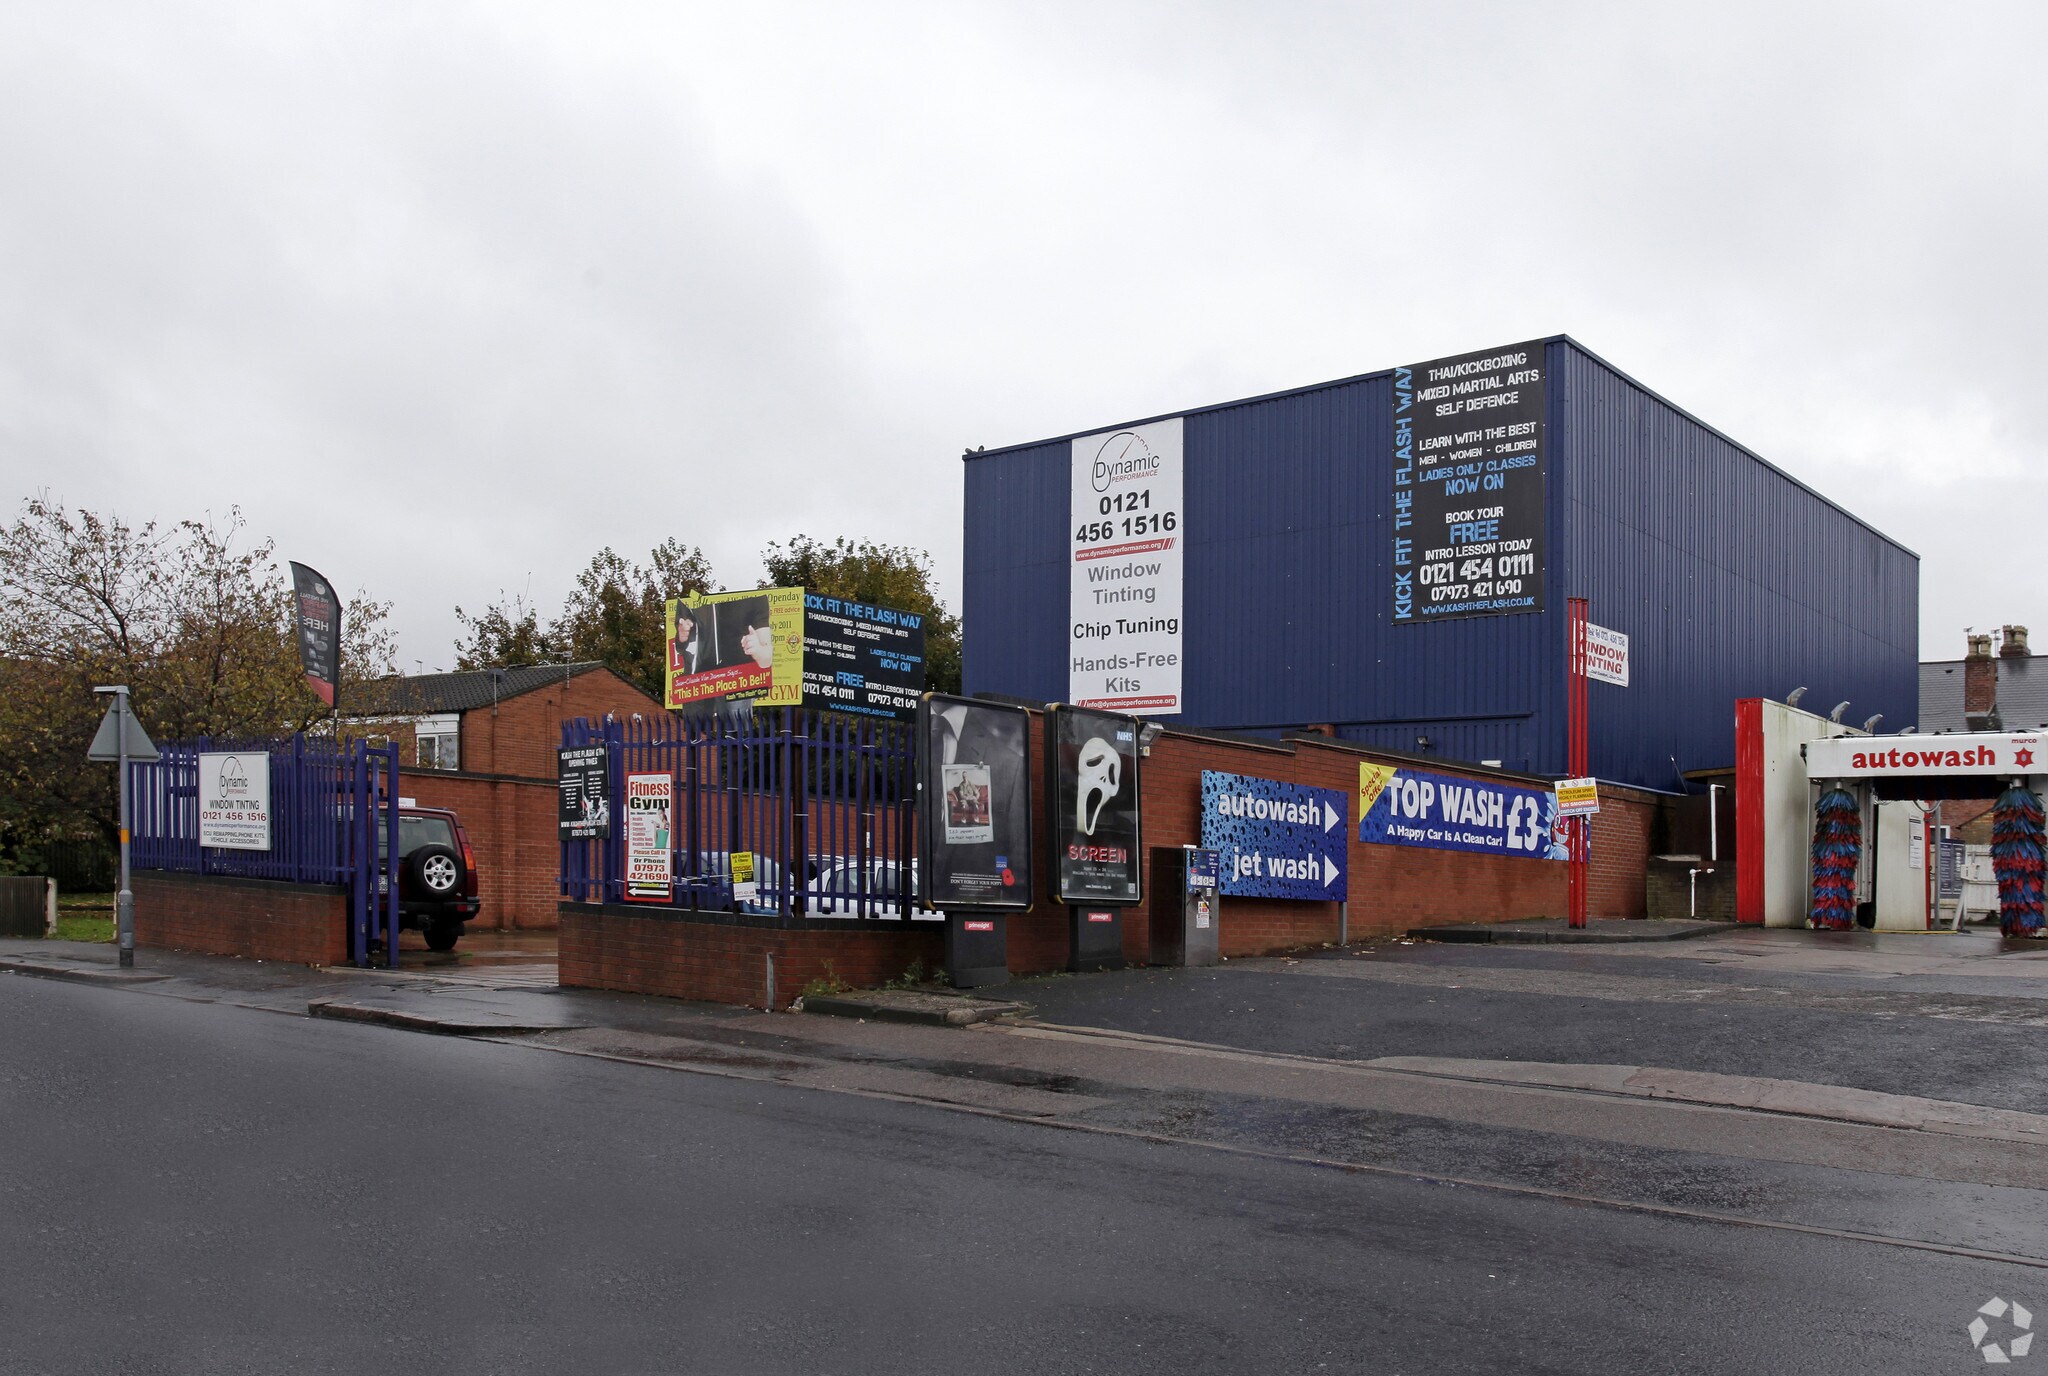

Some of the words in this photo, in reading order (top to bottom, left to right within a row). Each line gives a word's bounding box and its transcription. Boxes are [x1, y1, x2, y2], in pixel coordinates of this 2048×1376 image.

[1428, 352, 1527, 381] THAI/KICKBOXING
[1395, 367, 1412, 414] WAY
[1417, 386, 1450, 402] MIXED
[1452, 376, 1504, 396] MARTIAL
[1507, 369, 1540, 386] ARTS
[1436, 401, 1464, 417] SELF
[1466, 391, 1519, 412] DEFENCE
[1419, 434, 1452, 451] LEARN
[1455, 430, 1482, 444] WITH
[1485, 426, 1506, 440] THE
[1508, 422, 1537, 437] BEST
[1395, 417, 1412, 486] FLASH
[1419, 455, 1437, 466] MEN
[1449, 448, 1482, 461] WOMEN
[1495, 439, 1537, 454] CHILDREN
[1095, 453, 1160, 482] Dynamic
[1111, 469, 1158, 483] PERFORMANCE
[1419, 466, 1454, 482] LADIES
[1456, 461, 1484, 476] ONLY
[1486, 454, 1536, 471] CLASSES
[1446, 477, 1479, 497] NOW
[1484, 473, 1504, 490] ON
[1099, 489, 1150, 516] 0121
[1395, 490, 1412, 531] THE
[1446, 509, 1474, 524] BOOK
[1477, 506, 1504, 519] YOUR
[1076, 520, 1114, 543] 456
[1121, 511, 1177, 537] 1516
[1450, 519, 1499, 545] FREE
[1076, 542, 1161, 560] www.dynamicperformance.org
[1395, 537, 1412, 566] FIT
[1425, 547, 1454, 561] INTRO
[1456, 542, 1496, 557] LESSON
[1498, 538, 1533, 552] TODAY
[1087, 562, 1162, 583] Window
[1420, 561, 1455, 585] 0121
[1460, 557, 1493, 581] 454
[1498, 553, 1534, 577] 0111
[768, 591, 801, 604] Openday
[1092, 586, 1156, 605] Tinting
[1395, 570, 1412, 619] KICK
[1431, 583, 1469, 601] 07973
[1473, 581, 1493, 597] 421
[1496, 579, 1522, 595] 690
[826, 598, 841, 613] FIT
[844, 602, 863, 619] THE
[865, 606, 897, 625] FLASH
[899, 613, 921, 629] WAY
[1421, 596, 1535, 615] WWW.KASHTHEFLASH.CO.UK
[778, 620, 792, 629] 2011
[843, 627, 857, 636] SELF
[856, 630, 881, 641] DEFENCE
[855, 621, 872, 631] MIXED
[871, 624, 895, 636] MARTIAL
[895, 629, 909, 638] ARTS
[1073, 622, 1112, 640] Chip
[1115, 617, 1179, 635] Tuning
[818, 638, 832, 648] WITH
[832, 642, 843, 650] THE
[842, 644, 856, 652] BEST
[869, 648, 887, 656] LADIES
[887, 651, 900, 660] ONLY
[899, 654, 922, 663] CLASSES
[880, 658, 899, 670] NOW
[900, 662, 911, 672] ON
[1073, 652, 1178, 673] Hands-Free
[692, 685, 699, 697] Is
[701, 683, 714, 695] The
[716, 680, 737, 693] Place
[739, 677, 748, 688] To
[769, 683, 800, 701] GYM
[803, 682, 820, 695] 0121
[821, 685, 837, 698] 454
[838, 688, 855, 700] 0111
[818, 674, 834, 684] YOUR
[836, 671, 864, 688] FREE
[865, 681, 882, 691] INTRO
[882, 684, 904, 694] LESSON
[1105, 677, 1141, 693] Kits
[867, 692, 891, 706] 07973
[892, 696, 904, 707] 421
[1086, 698, 1175, 708] info@dynamicperformance.org
[1116, 731, 1133, 742] NHS
[1852, 745, 1996, 769] autowash
[220, 775, 249, 794] Dynamic
[630, 781, 670, 796] Fitness
[1360, 767, 1382, 797] Special
[1368, 779, 1384, 802] Offer
[209, 800, 235, 810] WINDOW
[236, 800, 260, 810] TINTING
[630, 796, 670, 810] Gym
[1218, 791, 1320, 826] autowash
[1385, 776, 1435, 820] TOP
[1439, 783, 1504, 829] WASH
[1506, 794, 1540, 851] £3
[202, 811, 222, 820] 0121
[225, 811, 243, 821] 456
[246, 812, 267, 822] 1516
[1386, 824, 1396, 835] A
[1397, 825, 1426, 842] Happy
[1426, 828, 1443, 840] Car
[1444, 830, 1452, 842] Is
[1453, 831, 1462, 843] A
[1463, 832, 1485, 845] Clean
[1486, 835, 1503, 847] Car!
[1068, 844, 1127, 864] SCREEN
[1232, 846, 1262, 882] jet
[1267, 853, 1320, 881] wash
[629, 872, 669, 881] 421690
[634, 864, 665, 872] 07973
